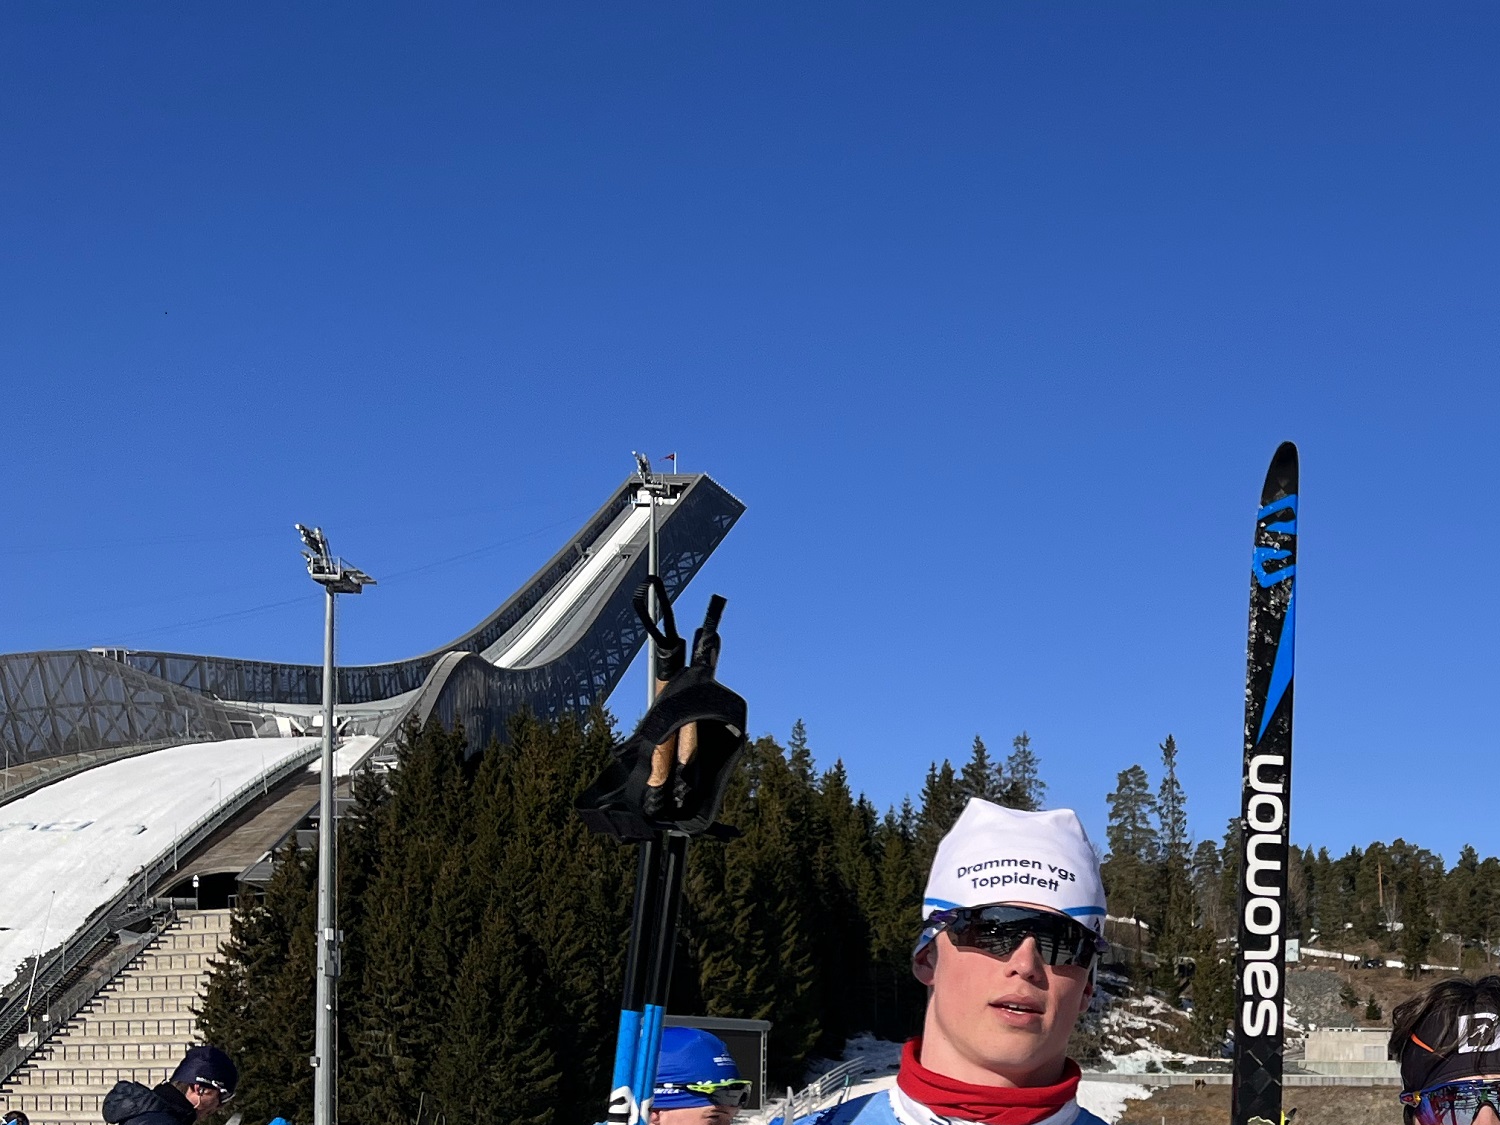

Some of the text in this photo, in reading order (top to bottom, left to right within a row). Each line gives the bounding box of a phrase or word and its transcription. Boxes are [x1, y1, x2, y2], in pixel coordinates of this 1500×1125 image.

[957, 856, 1076, 883] Drammen vgs
[972, 872, 1059, 892] Toppidrett
[1243, 754, 1285, 1037] salomon
